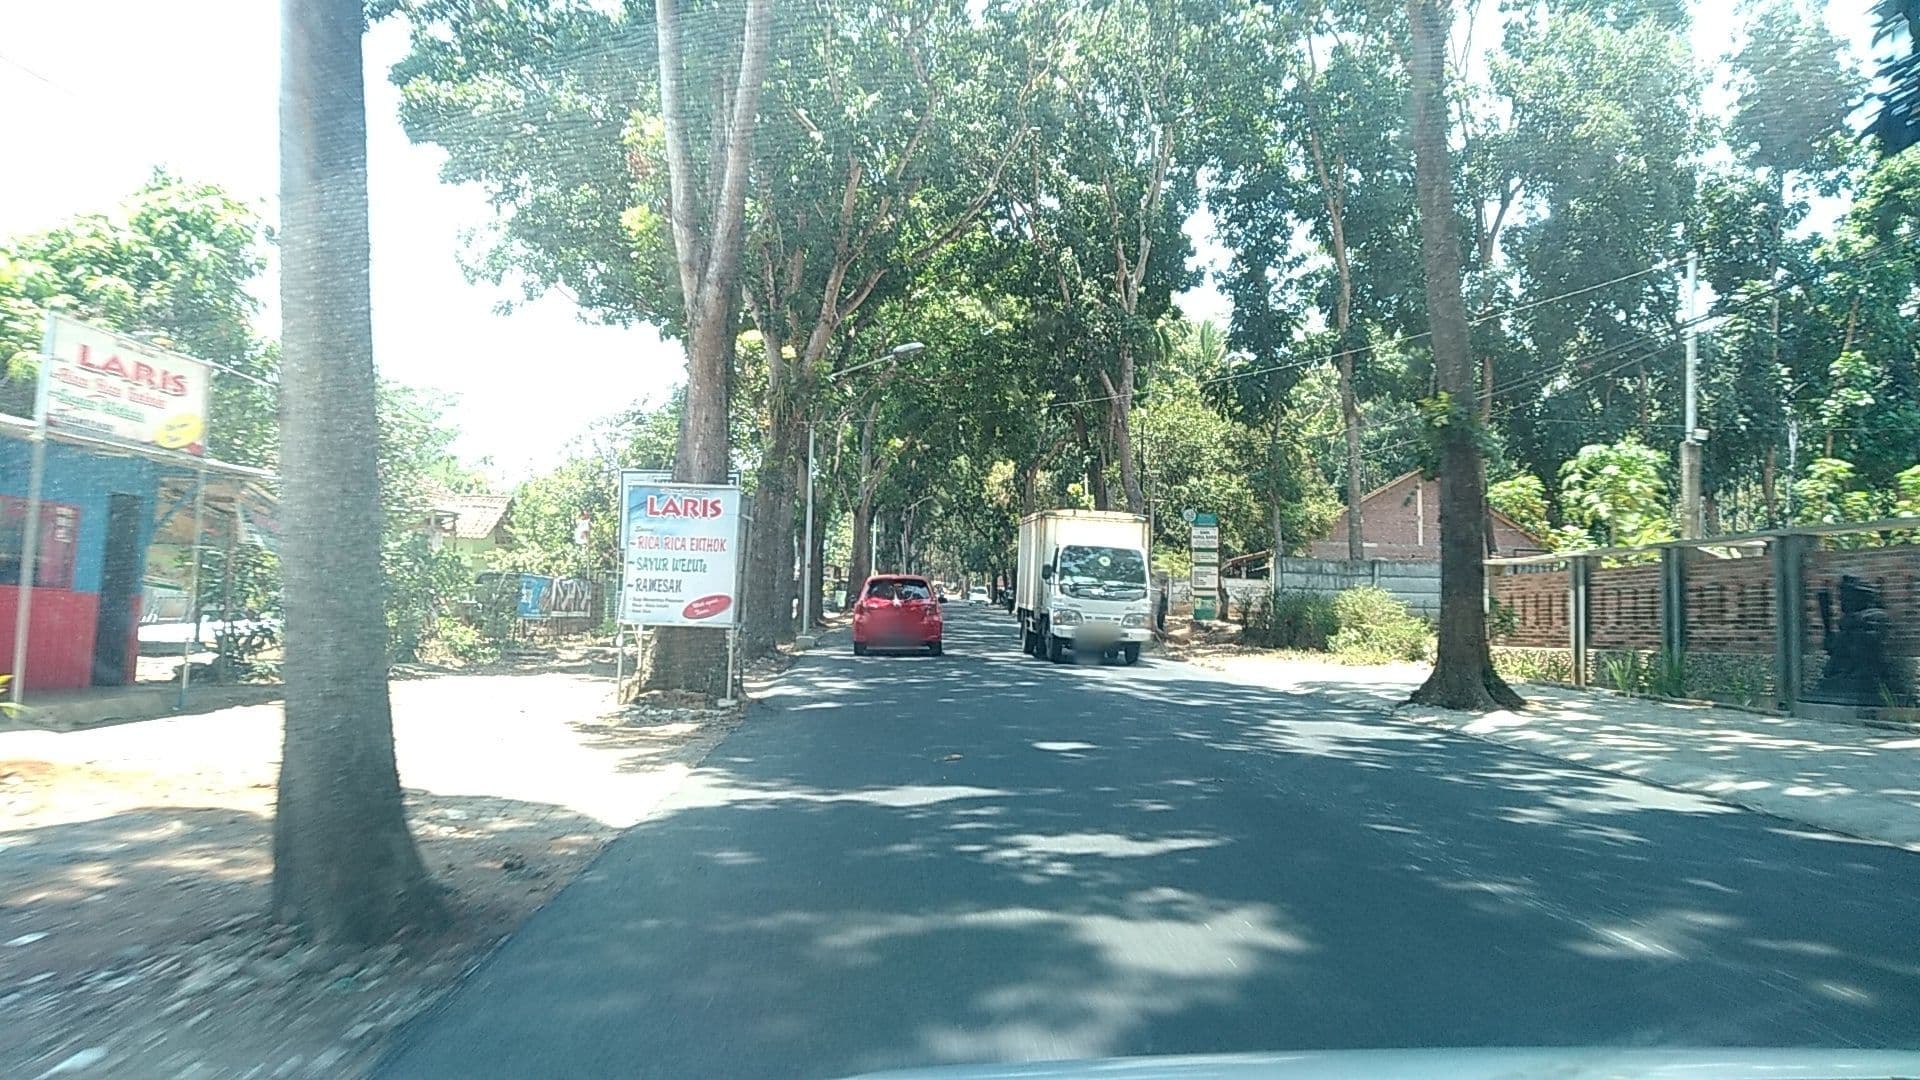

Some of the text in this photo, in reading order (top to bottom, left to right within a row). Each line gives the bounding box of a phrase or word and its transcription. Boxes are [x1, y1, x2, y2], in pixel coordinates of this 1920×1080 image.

[77, 344, 188, 396] LARIS
[648, 496, 723, 518] LARIS
[637, 535, 727, 552] RICA RICA ENTHOK
[636, 557, 669, 572] SAYUR
[635, 578, 683, 593] RAMESAN
